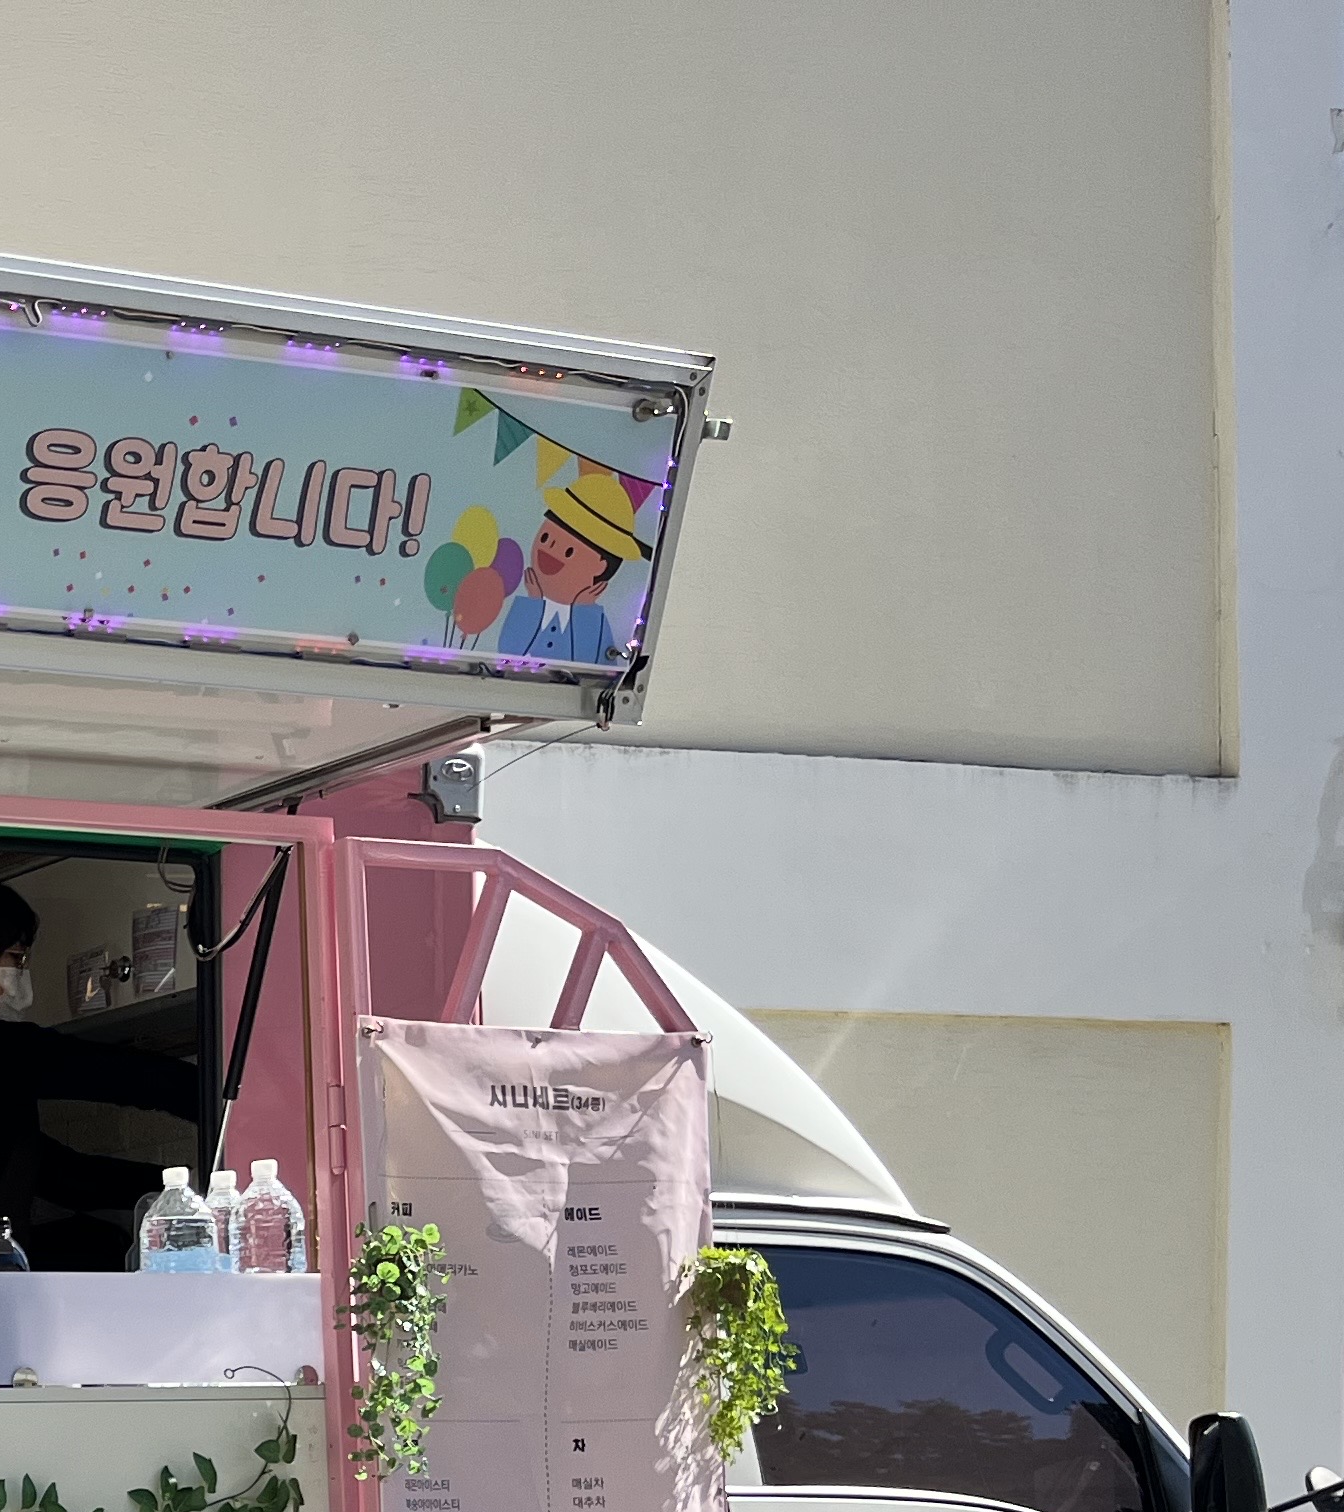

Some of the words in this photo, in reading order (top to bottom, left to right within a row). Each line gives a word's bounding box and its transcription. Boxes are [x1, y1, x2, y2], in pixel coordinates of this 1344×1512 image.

[19, 428, 431, 557] 응원합니다!
[391, 1201, 413, 1217] 커피
[564, 1206, 603, 1222] 에이드
[567, 1245, 618, 1258] 레몬에이드
[569, 1263, 627, 1276] 청포도에이드
[571, 1282, 617, 1295] 망고에이드
[572, 1301, 638, 1314] 블루베리에이드
[569, 1319, 649, 1332] 히비스커스에이드
[569, 1339, 618, 1352] 매실에이드
[572, 1438, 586, 1452] 차
[572, 1477, 604, 1490] 매실차
[573, 1496, 606, 1509] 대추차
